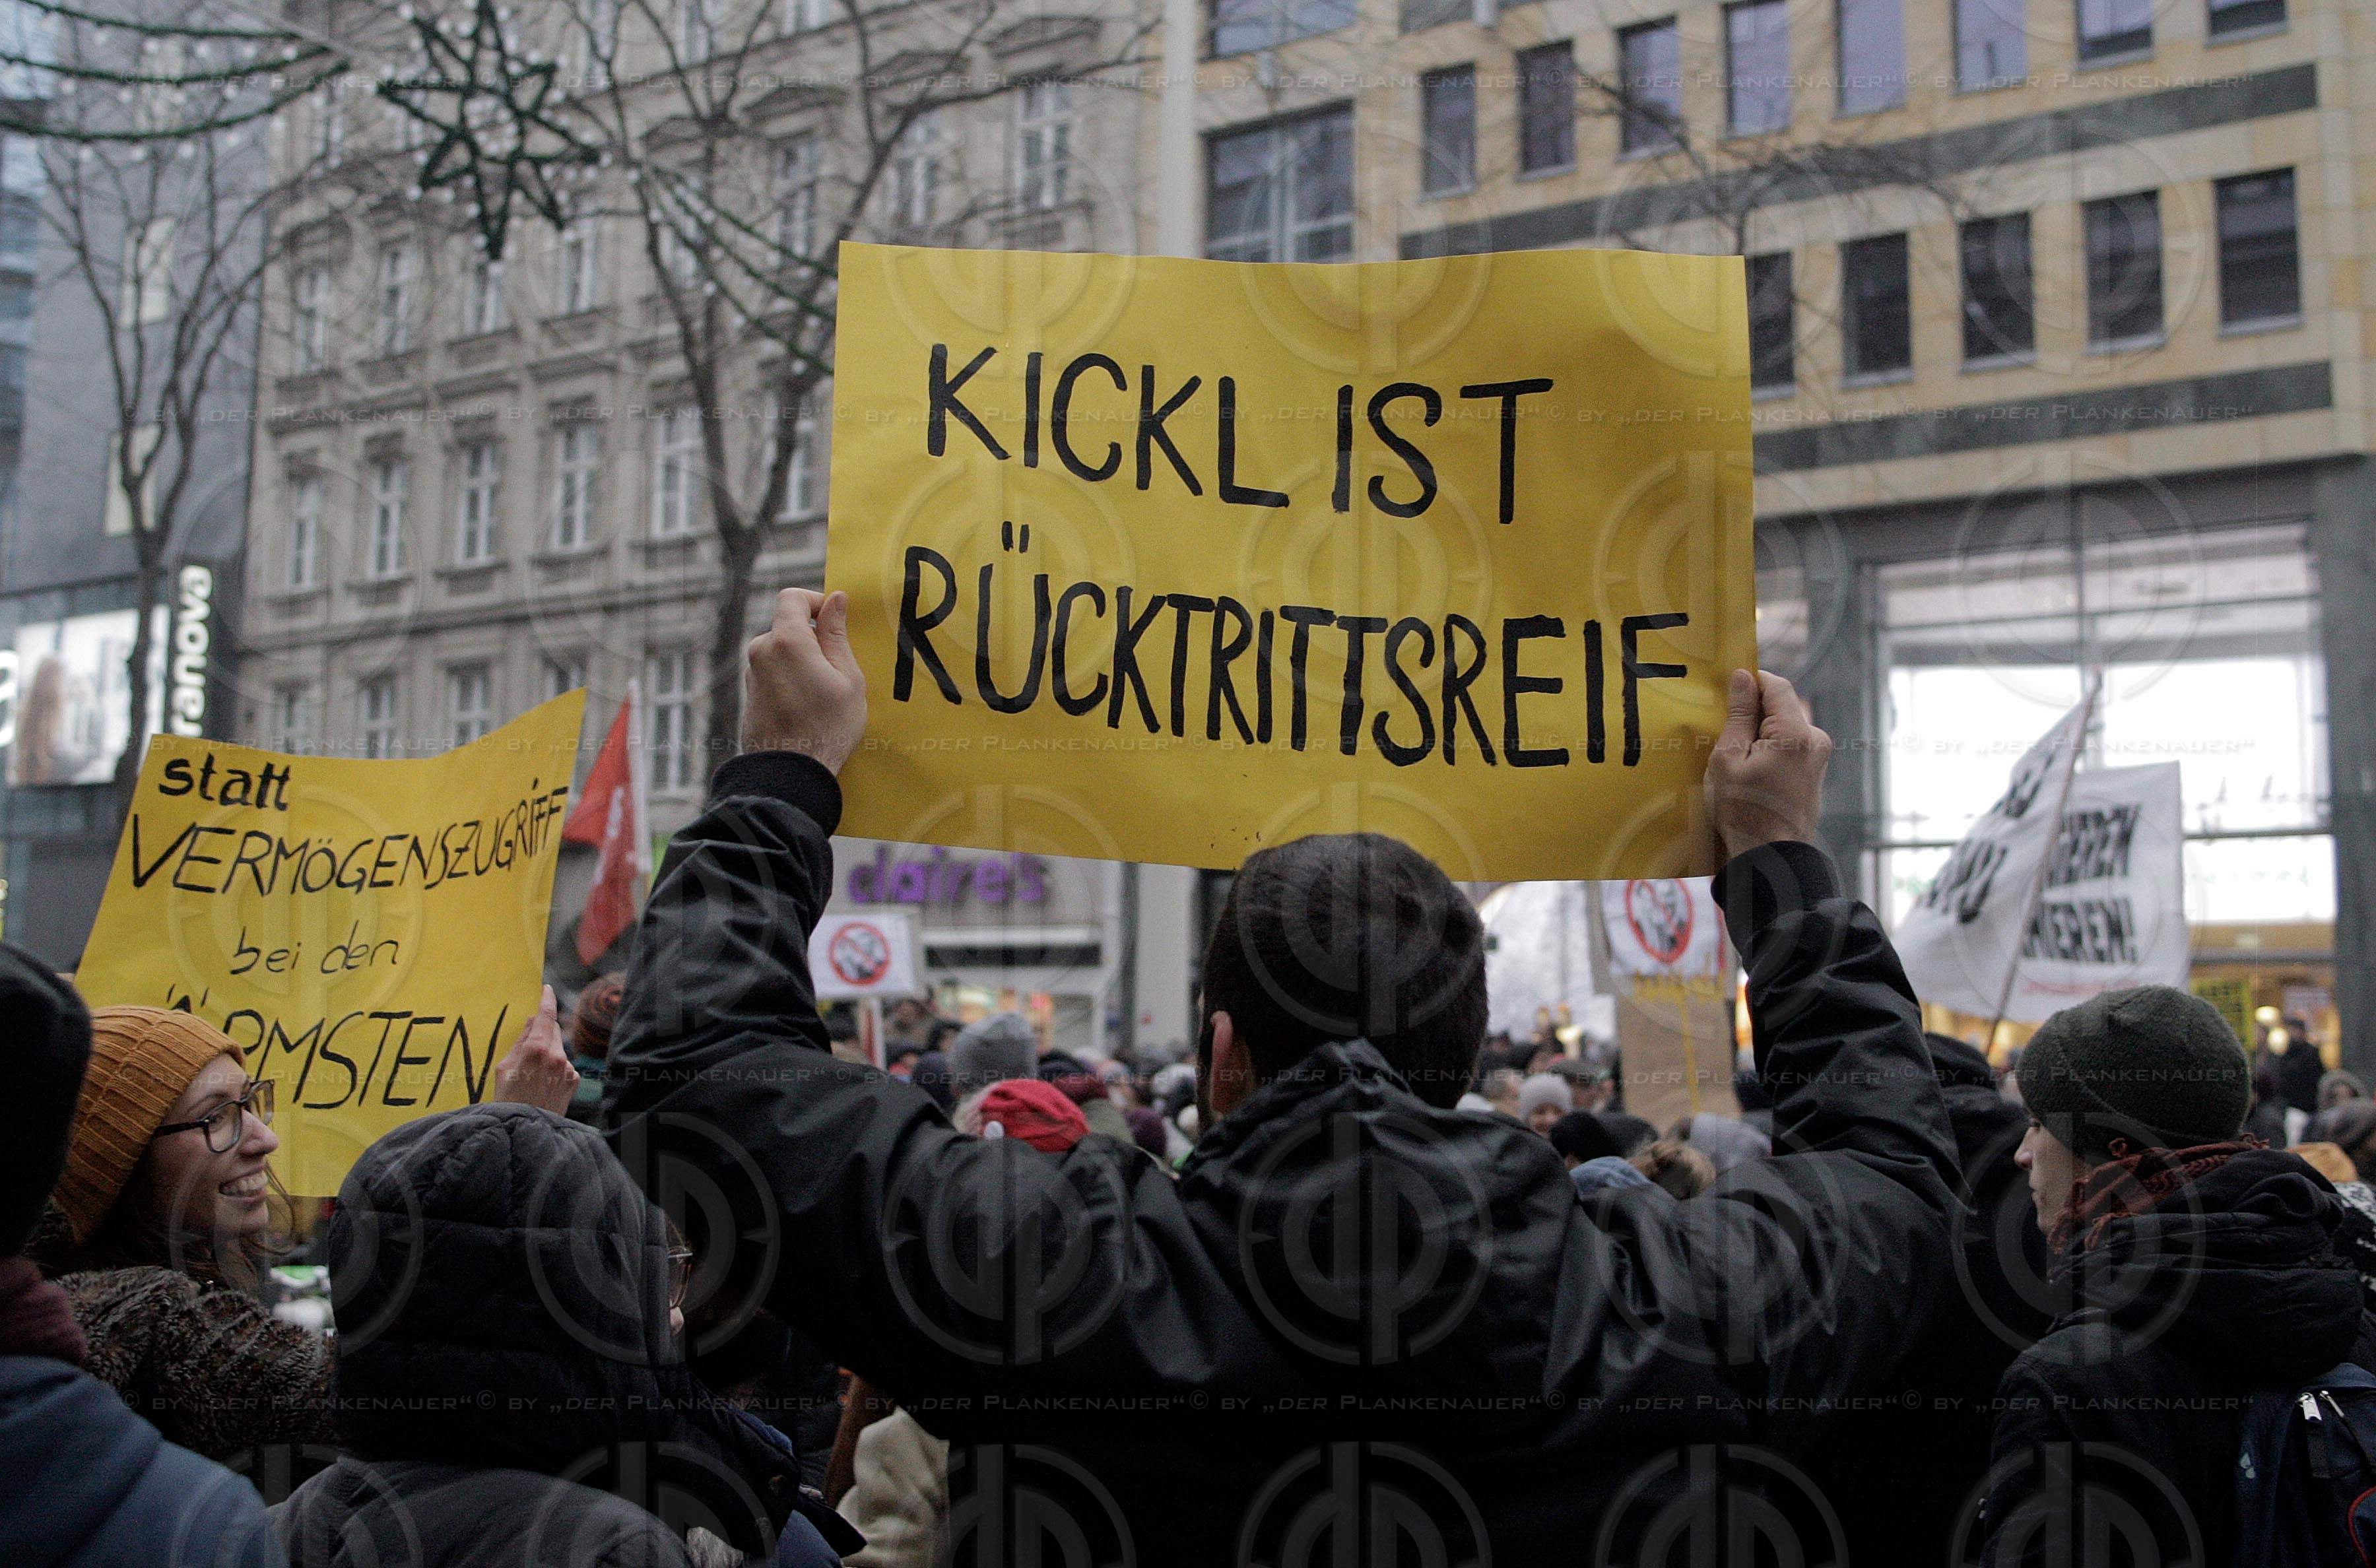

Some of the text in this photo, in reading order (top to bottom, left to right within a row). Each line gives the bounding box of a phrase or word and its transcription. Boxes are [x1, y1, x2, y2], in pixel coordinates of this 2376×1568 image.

[928, 344, 1554, 524] KICKL IST
[894, 521, 1690, 768] RÜCKTRITTSREIF
[158, 752, 290, 811] statt
[230, 919, 399, 975] bei den
[167, 983, 508, 1109] MSTEN
